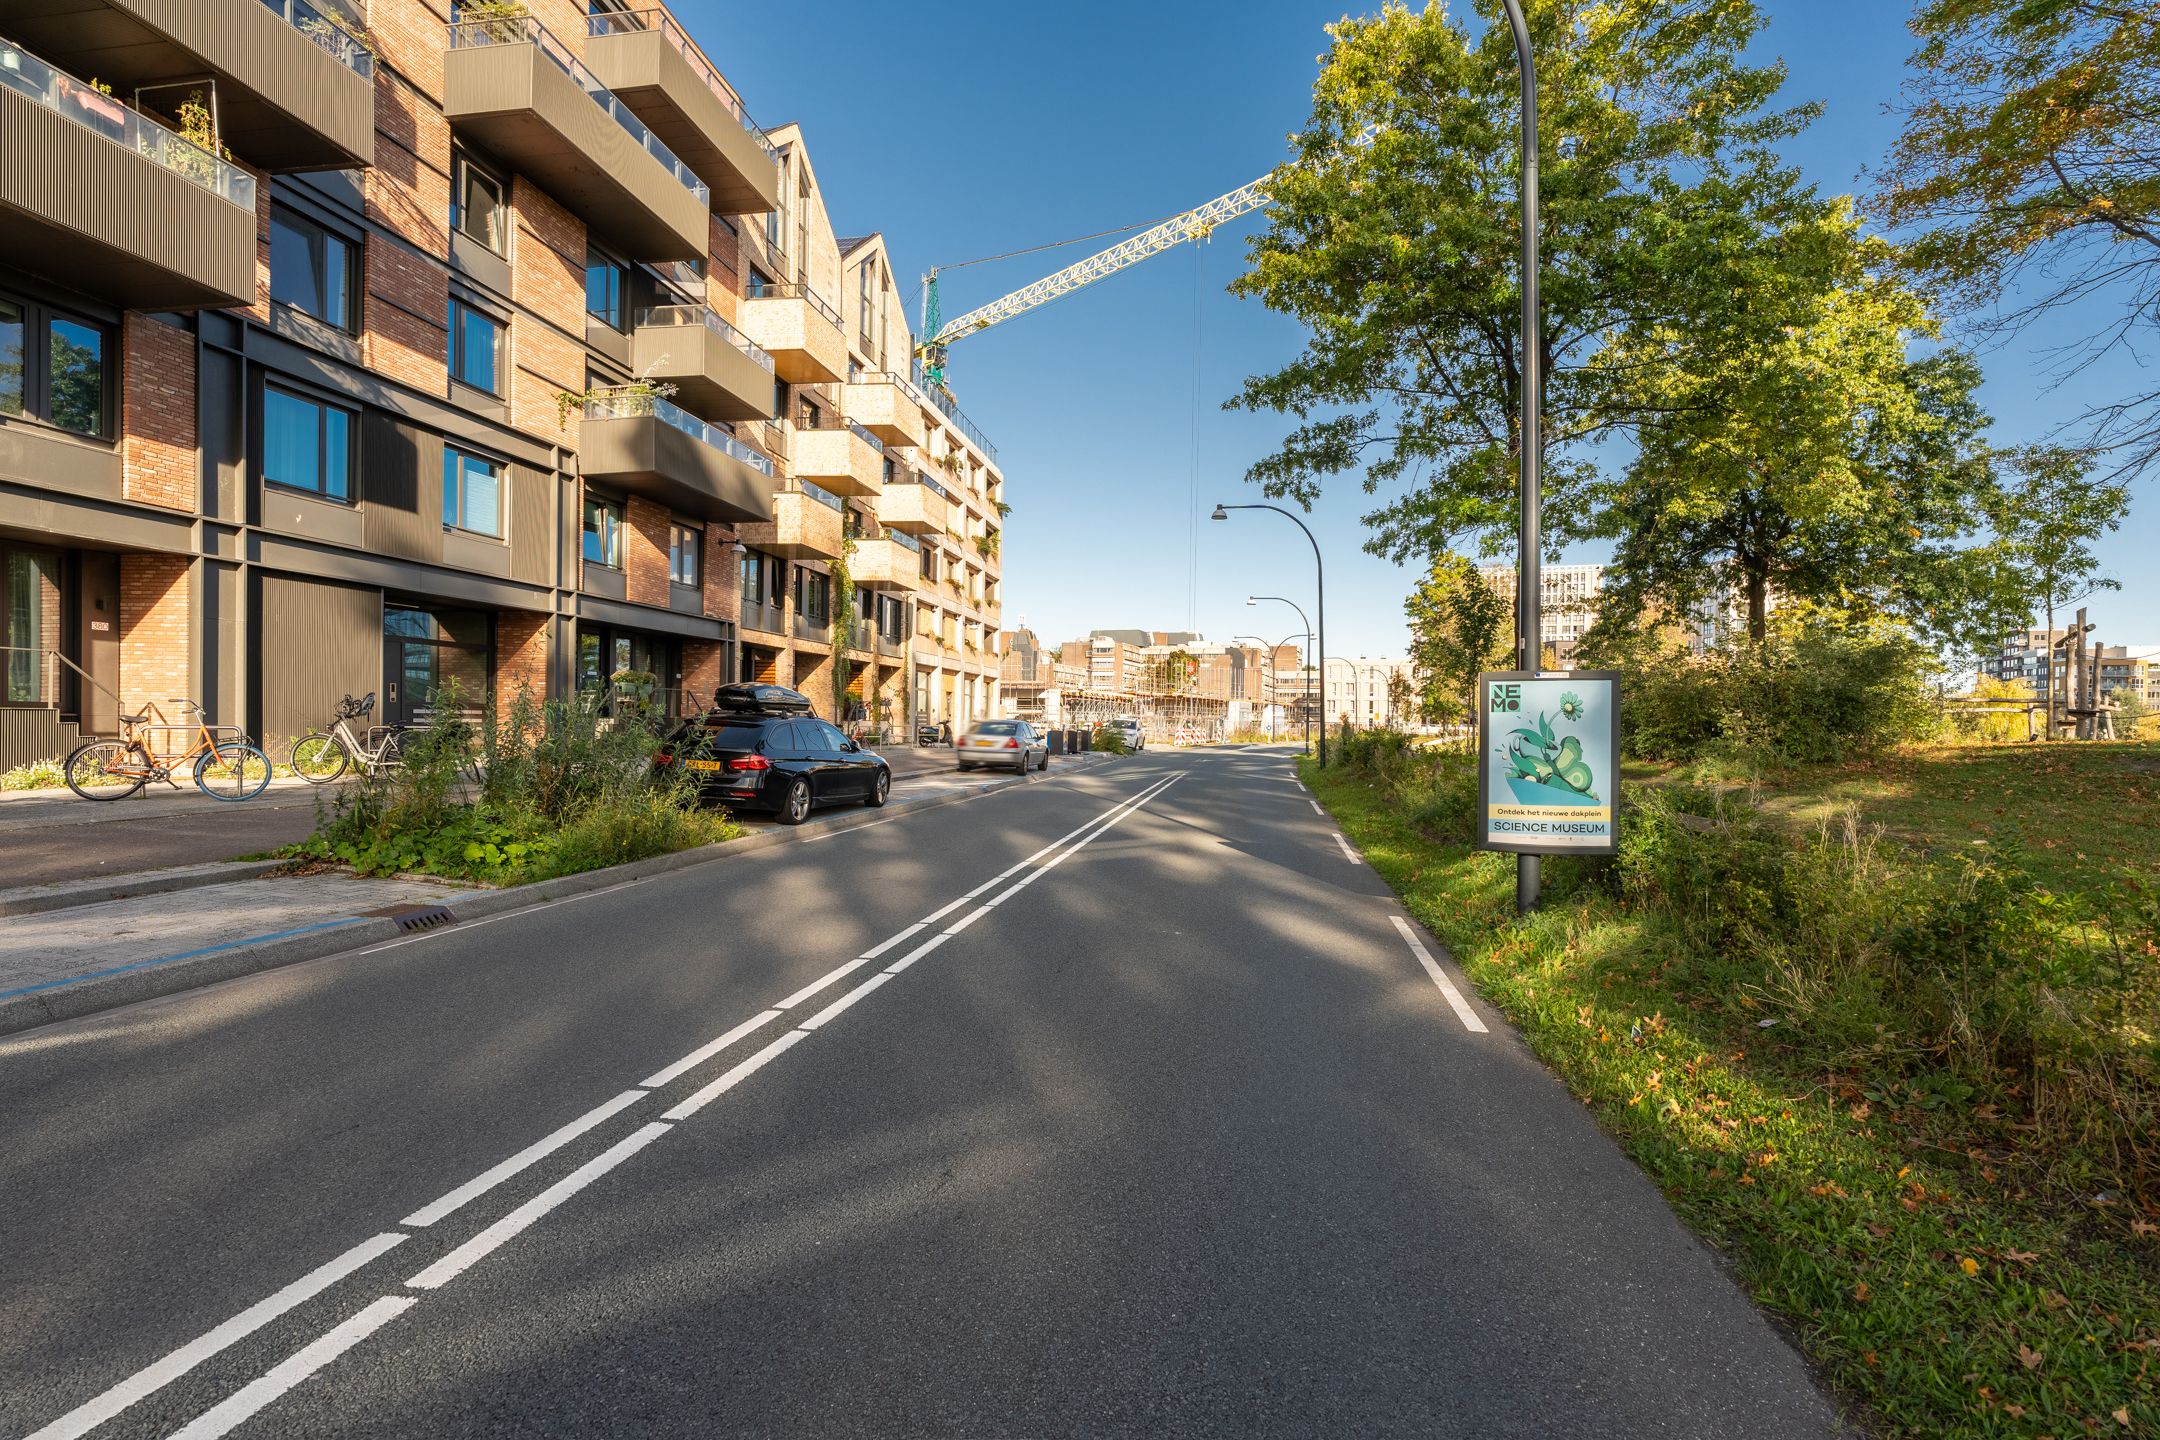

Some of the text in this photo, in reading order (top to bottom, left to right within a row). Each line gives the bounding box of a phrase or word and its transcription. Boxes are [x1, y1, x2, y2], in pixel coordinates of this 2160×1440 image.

[1497, 808, 1602, 818] Ontdek het nieuwe dakplein
[1494, 821, 1605, 833] SCIENCE MUSEUM
